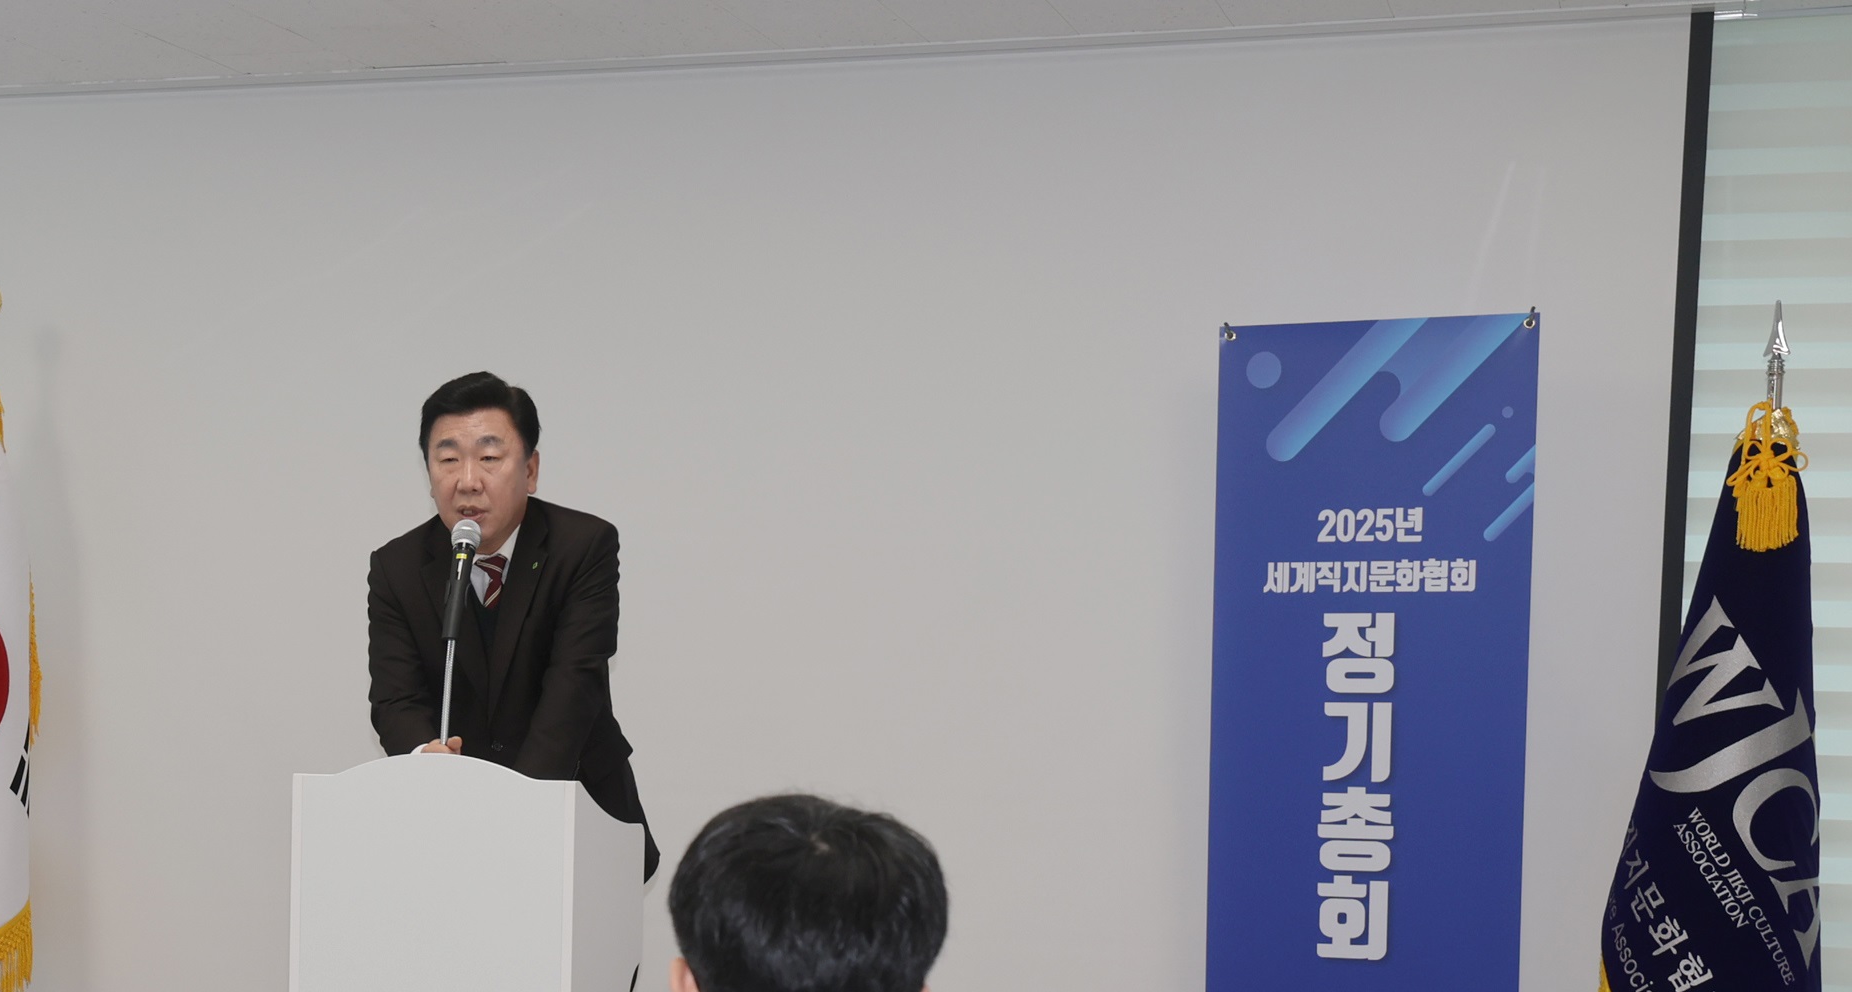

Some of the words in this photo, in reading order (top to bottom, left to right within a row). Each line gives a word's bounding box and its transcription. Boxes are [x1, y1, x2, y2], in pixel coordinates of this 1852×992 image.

[1263, 557, 1477, 594] 세계직지문화협회
[1317, 506, 1424, 543] 2025년
[1316, 612, 1396, 961] 정기총회
[1673, 823, 1750, 928] ASSOCIATION
[1688, 807, 1731, 868] WORLD
[1723, 869, 1755, 905] JIKJI
[1748, 905, 1795, 986] CULTURE
